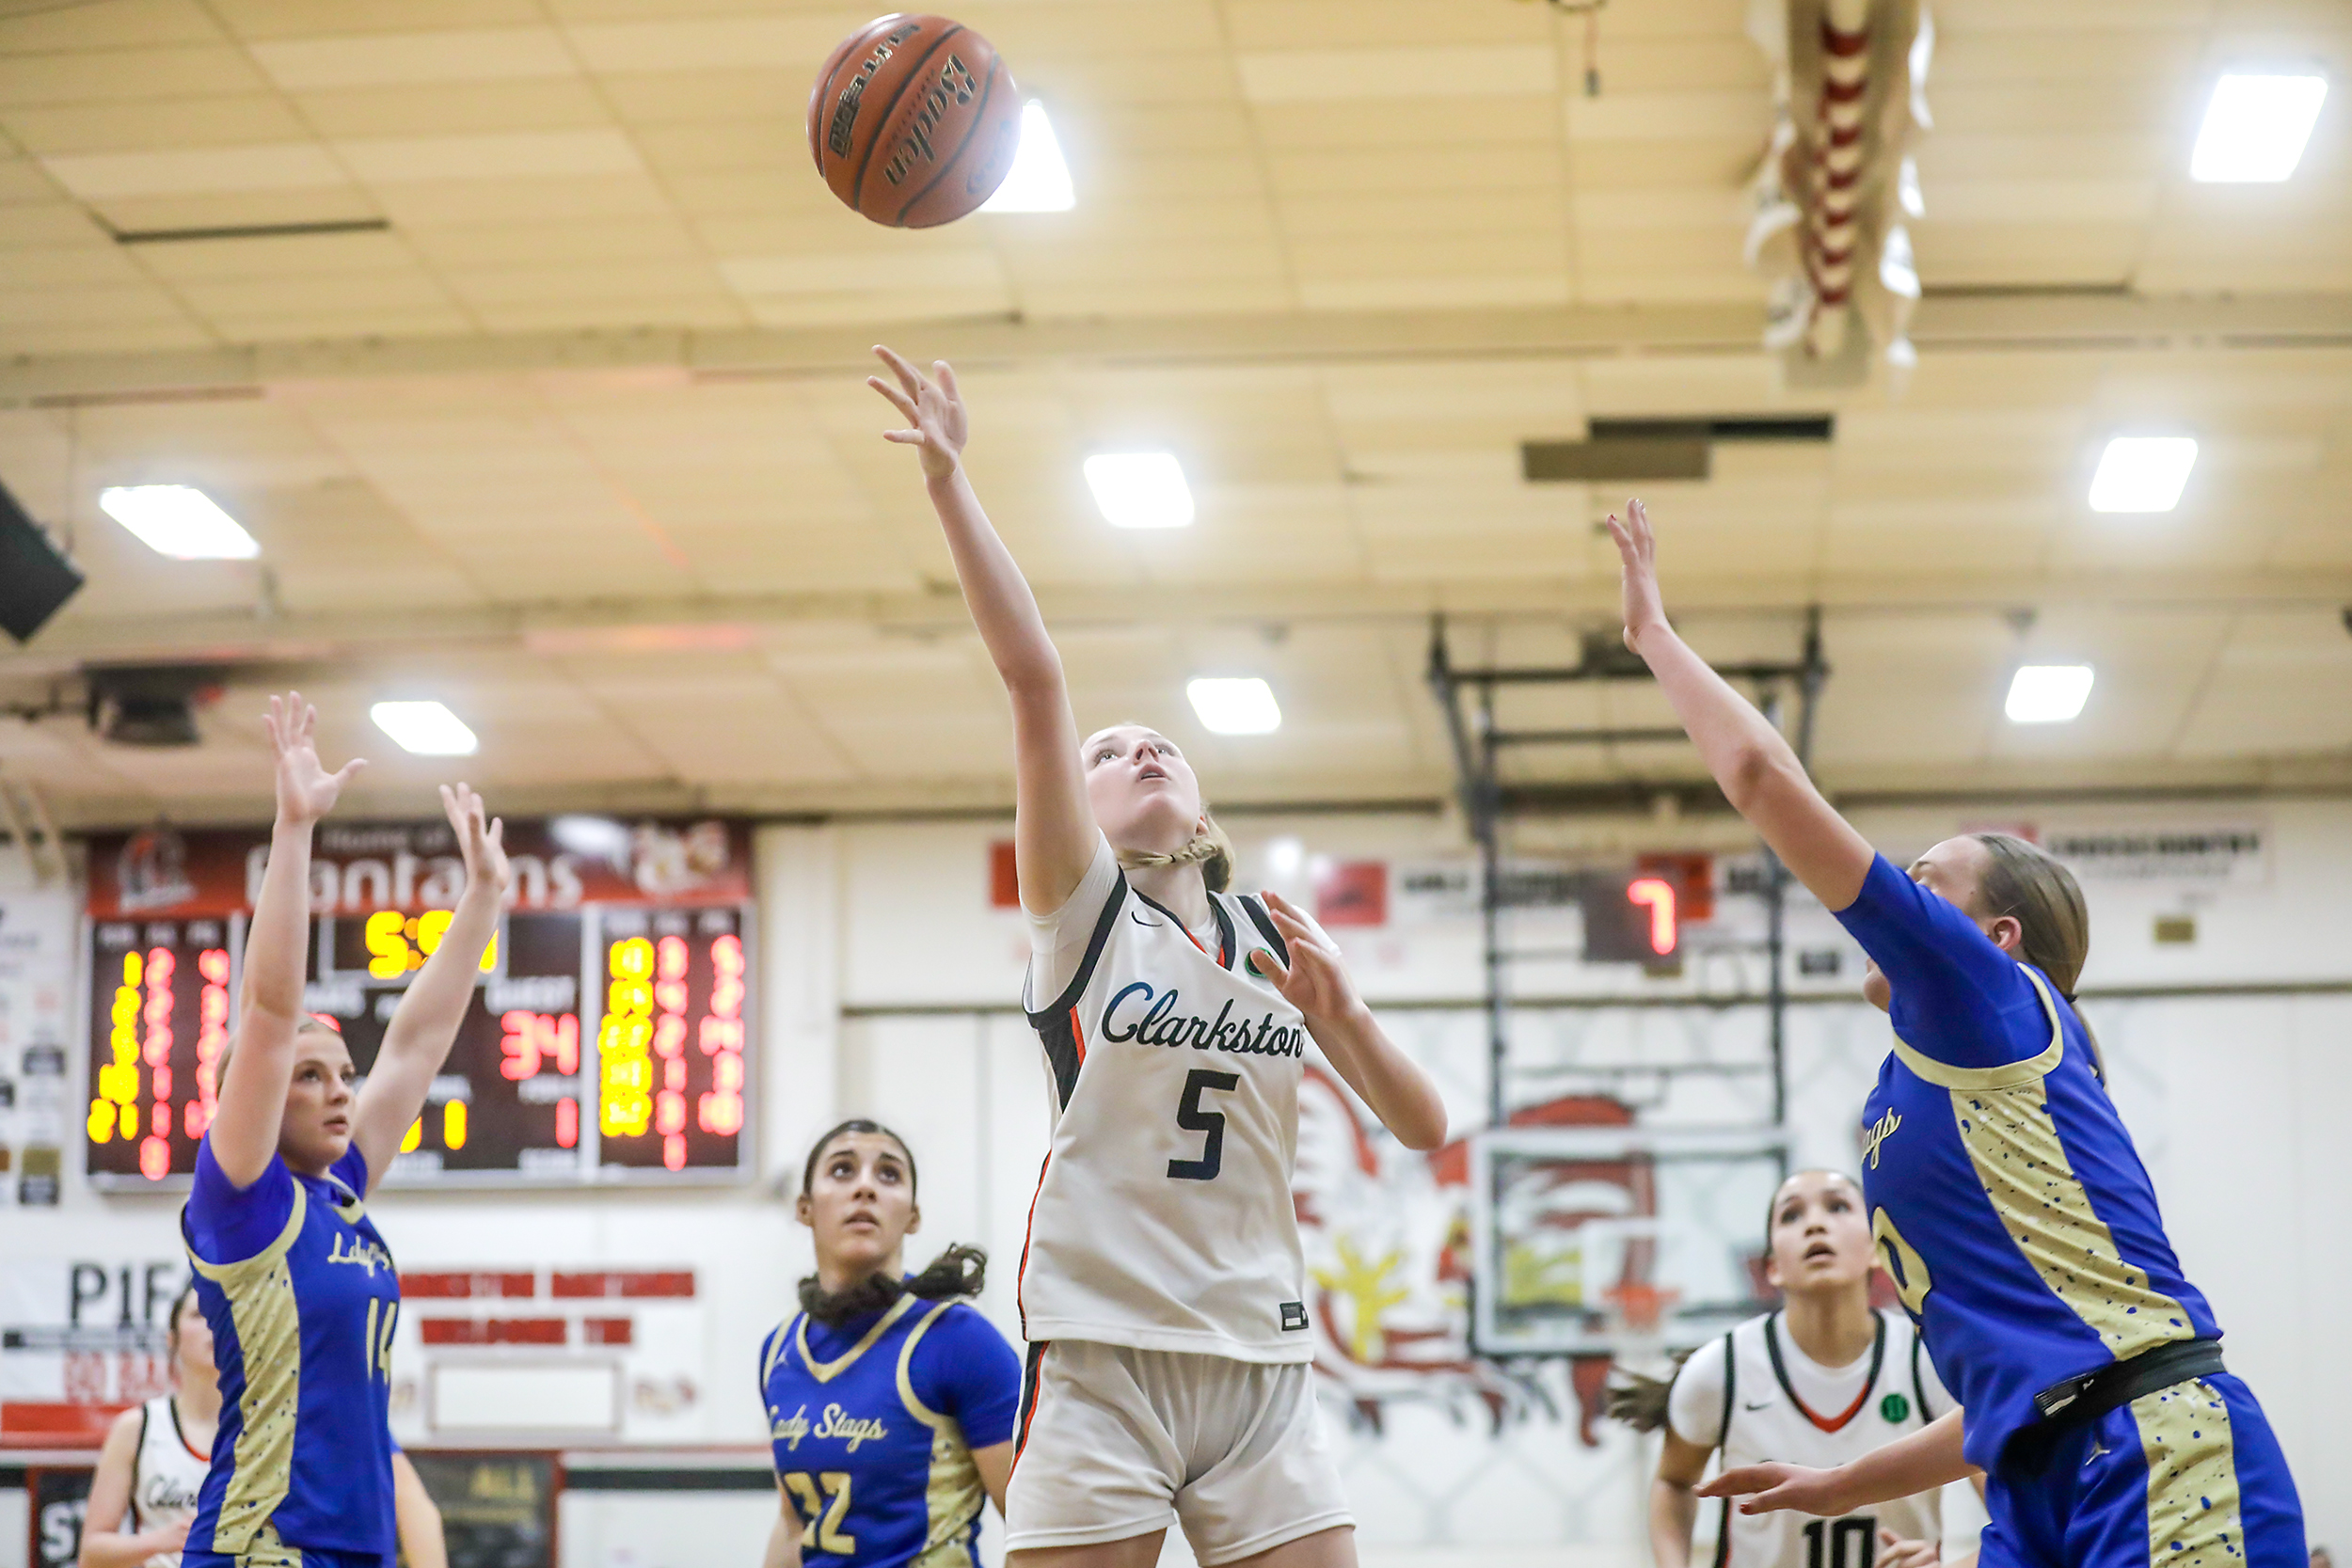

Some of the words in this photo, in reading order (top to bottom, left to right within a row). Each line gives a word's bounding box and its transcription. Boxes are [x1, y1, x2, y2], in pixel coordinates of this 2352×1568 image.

[883, 53, 977, 185] Baden
[1628, 878, 1677, 954] 7
[501, 1010, 580, 1080] 34
[1102, 981, 1304, 1059] Clarkston
[1167, 1069, 1240, 1180] 5
[813, 1402, 888, 1453] Stags
[784, 1470, 856, 1555] 22
[1803, 1515, 1877, 1568] 10
